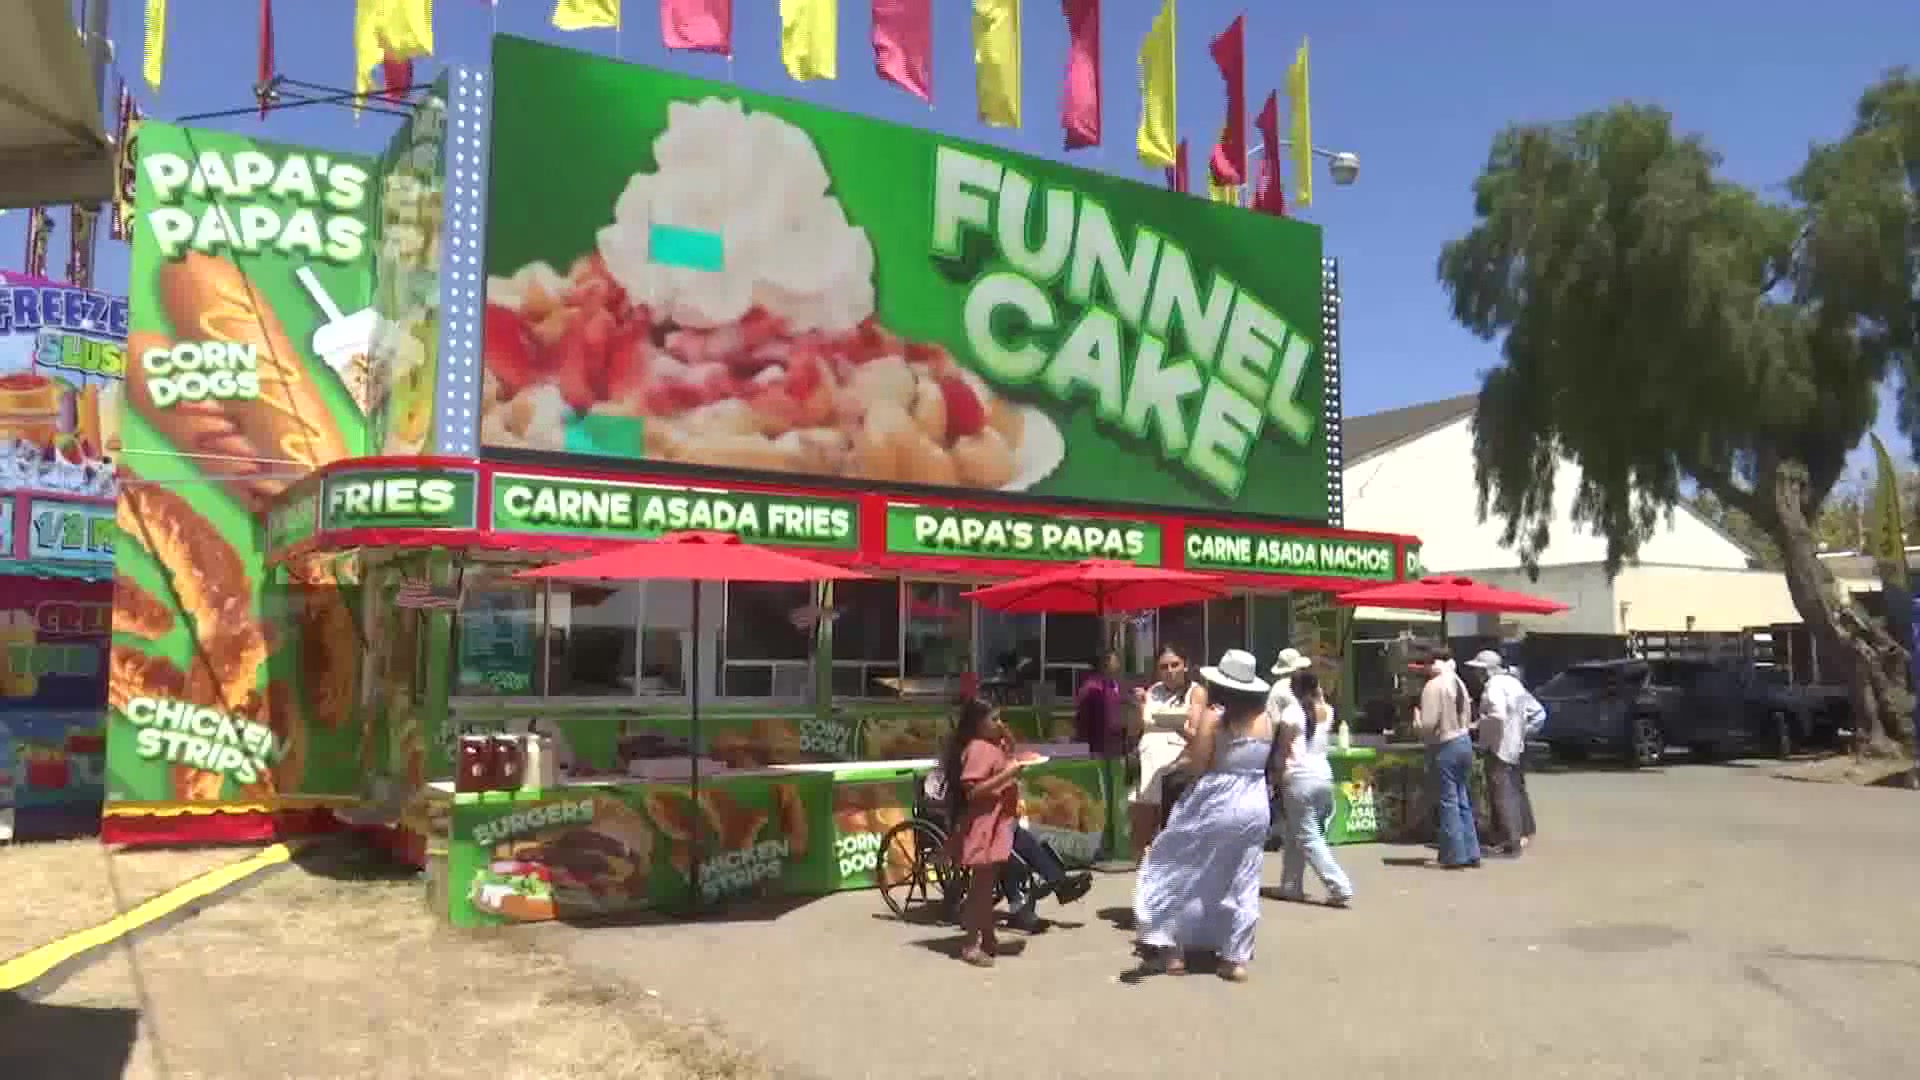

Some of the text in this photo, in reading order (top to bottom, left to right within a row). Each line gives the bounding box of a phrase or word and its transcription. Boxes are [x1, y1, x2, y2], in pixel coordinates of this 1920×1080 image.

[143, 151, 368, 208] PAPA'S
[147, 205, 367, 261] PAPAS
[931, 144, 1314, 445] FUNNEL
[143, 341, 257, 377] CORN
[963, 271, 1265, 499] CAKE
[148, 371, 259, 408] DOGS
[329, 478, 457, 516] FRIES
[503, 486, 849, 538] CARNE ASADA FRIES
[914, 515, 1144, 555] PAPA'S PAPAS
[1187, 535, 1389, 571] CARNE ASADA NACHOS
[126, 696, 290, 763] CHICKEN
[136, 728, 264, 784] STRIPS
[473, 800, 592, 847] BURGERS
